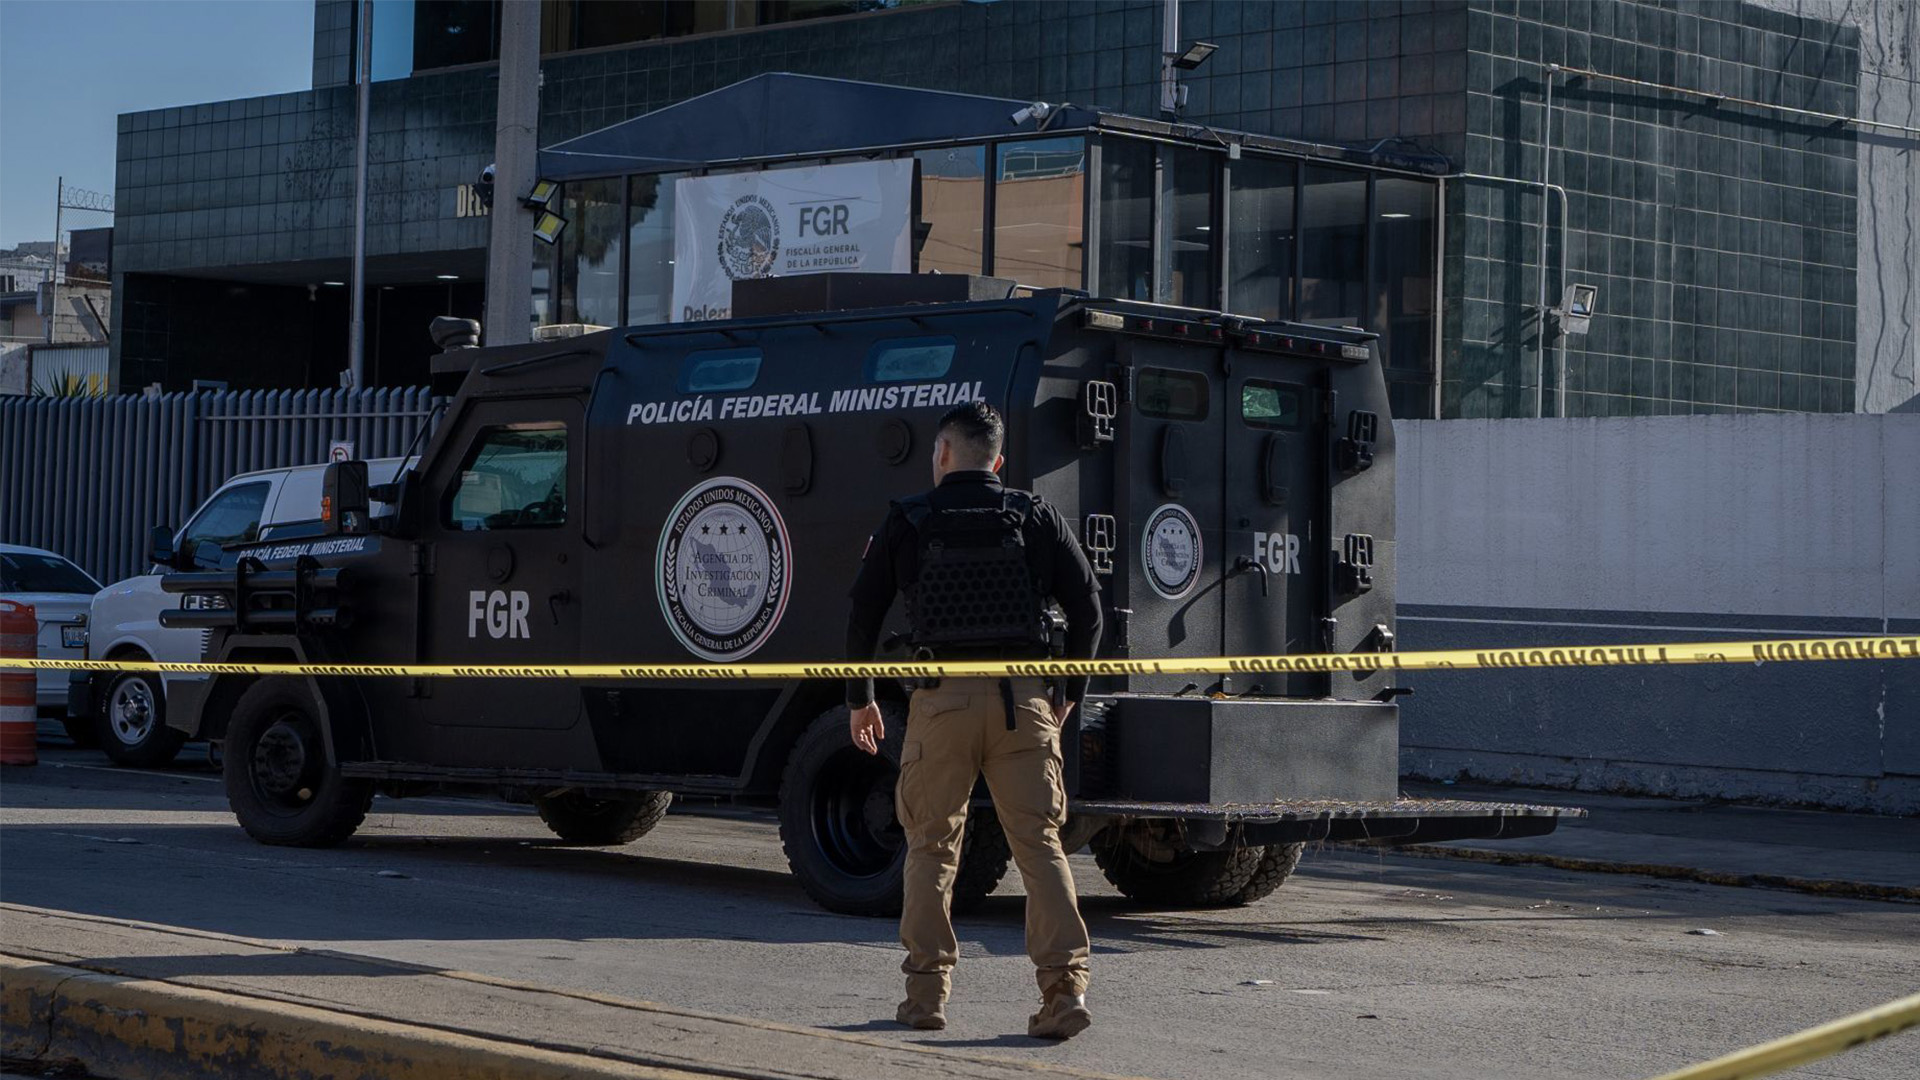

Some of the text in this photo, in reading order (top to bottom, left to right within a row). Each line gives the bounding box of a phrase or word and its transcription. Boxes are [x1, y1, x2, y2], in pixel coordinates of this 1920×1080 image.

[457, 184, 488, 218] DEL
[718, 194, 780, 239] ESTADOS UNIDOS MEXICANOS
[799, 204, 849, 238] FGR
[786, 244, 860, 256] FISCALÍA GENERAL
[787, 256, 858, 268] DE LA REPÚBLICA
[627, 382, 986, 425] POLICÍA FEDERAL MINISTERIAL
[675, 488, 774, 534] ESTADOS UNIDOS MEXICANOS
[270, 544, 308, 560] FEDERAL
[309, 538, 366, 555] MINISTERIAL
[1254, 532, 1301, 574] FGR
[468, 590, 530, 639] FGR
[694, 632, 723, 650] GENERAL
[724, 640, 733, 650] DE
[734, 637, 744, 648] LA
